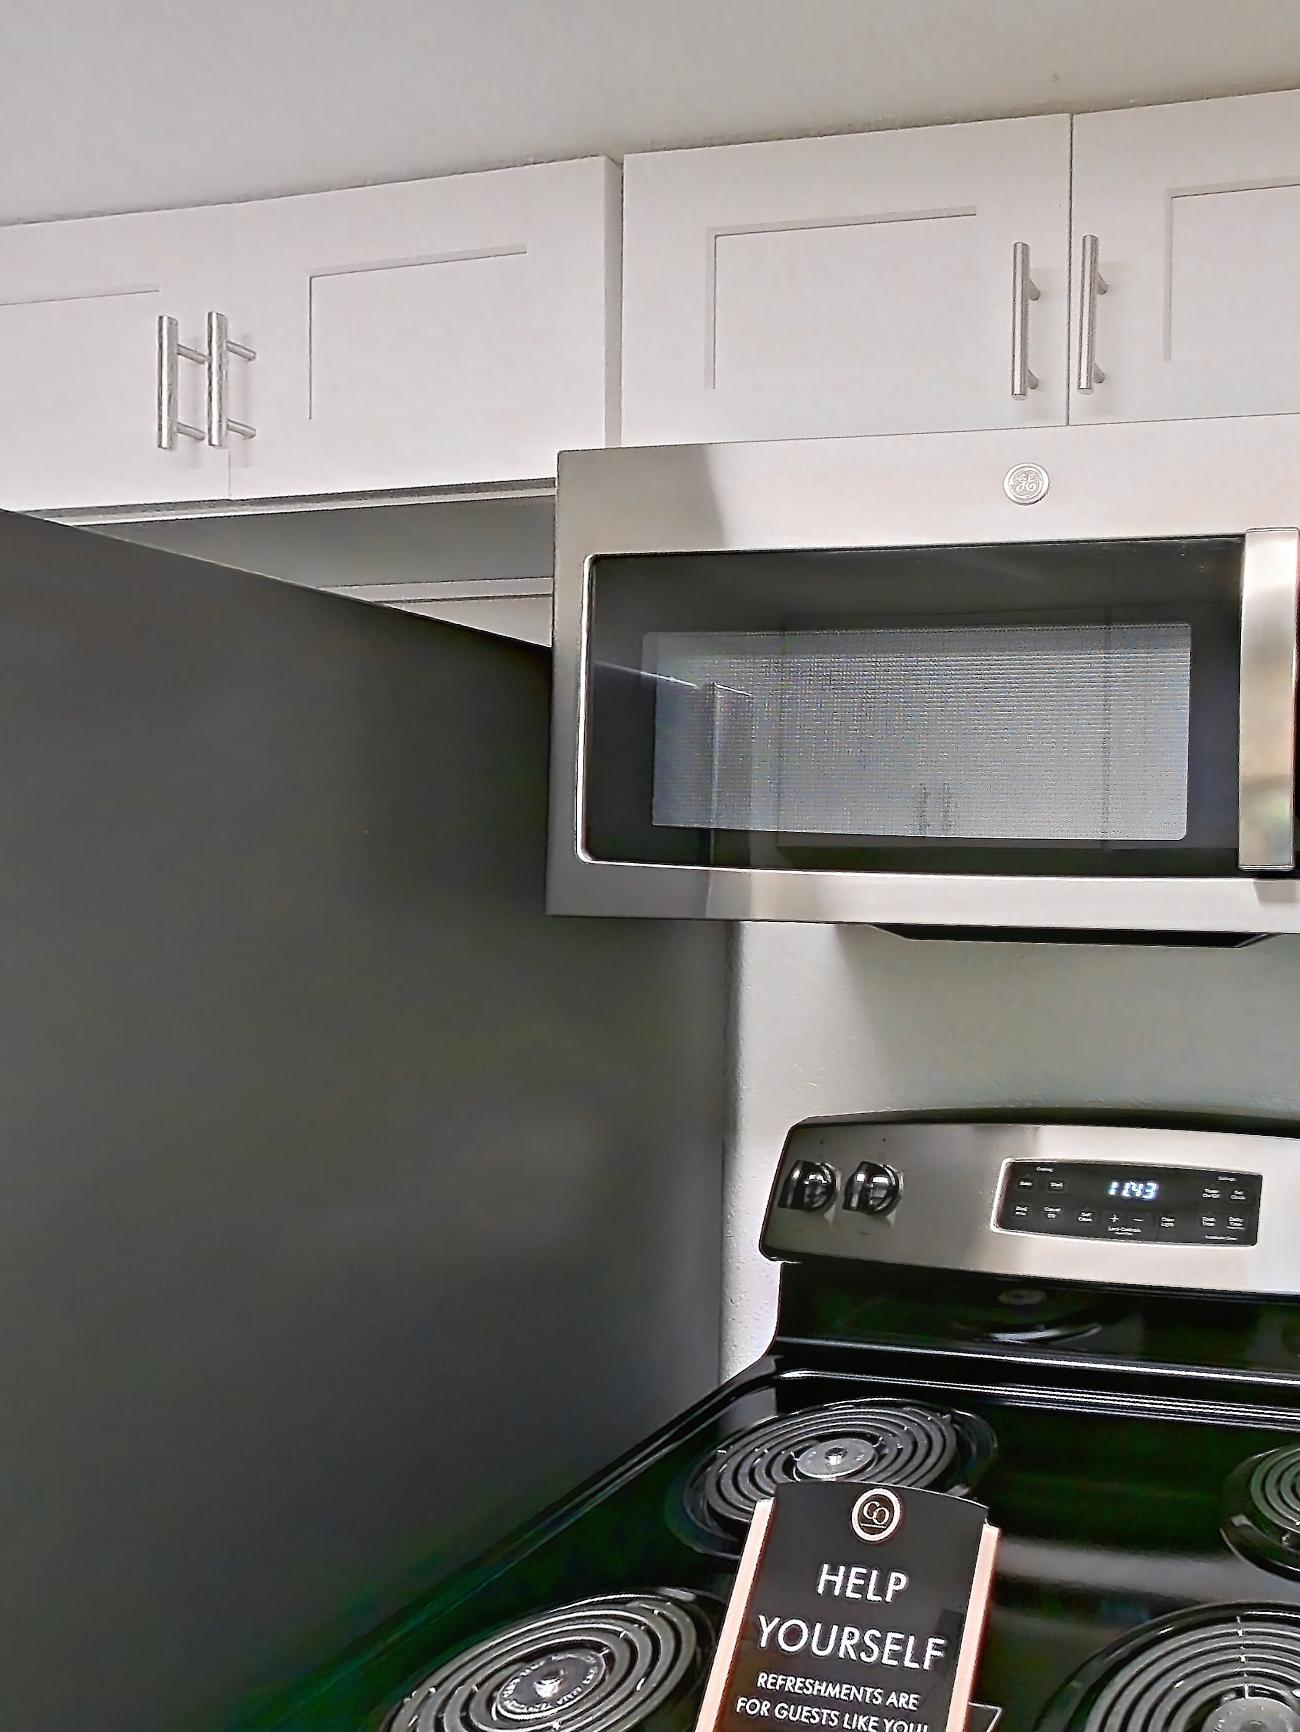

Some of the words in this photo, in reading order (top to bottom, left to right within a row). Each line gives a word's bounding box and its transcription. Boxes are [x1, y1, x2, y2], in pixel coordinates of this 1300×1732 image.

[816, 1563, 909, 1604] HELP
[757, 1615, 947, 1671] YOURSELF
[756, 1672, 884, 1706] REFRESHMENTS
[887, 1690, 921, 1712] ARE
[736, 1697, 770, 1718] FOR
[774, 1702, 839, 1728] GUESTS
[843, 1711, 880, 1732] LIKE
